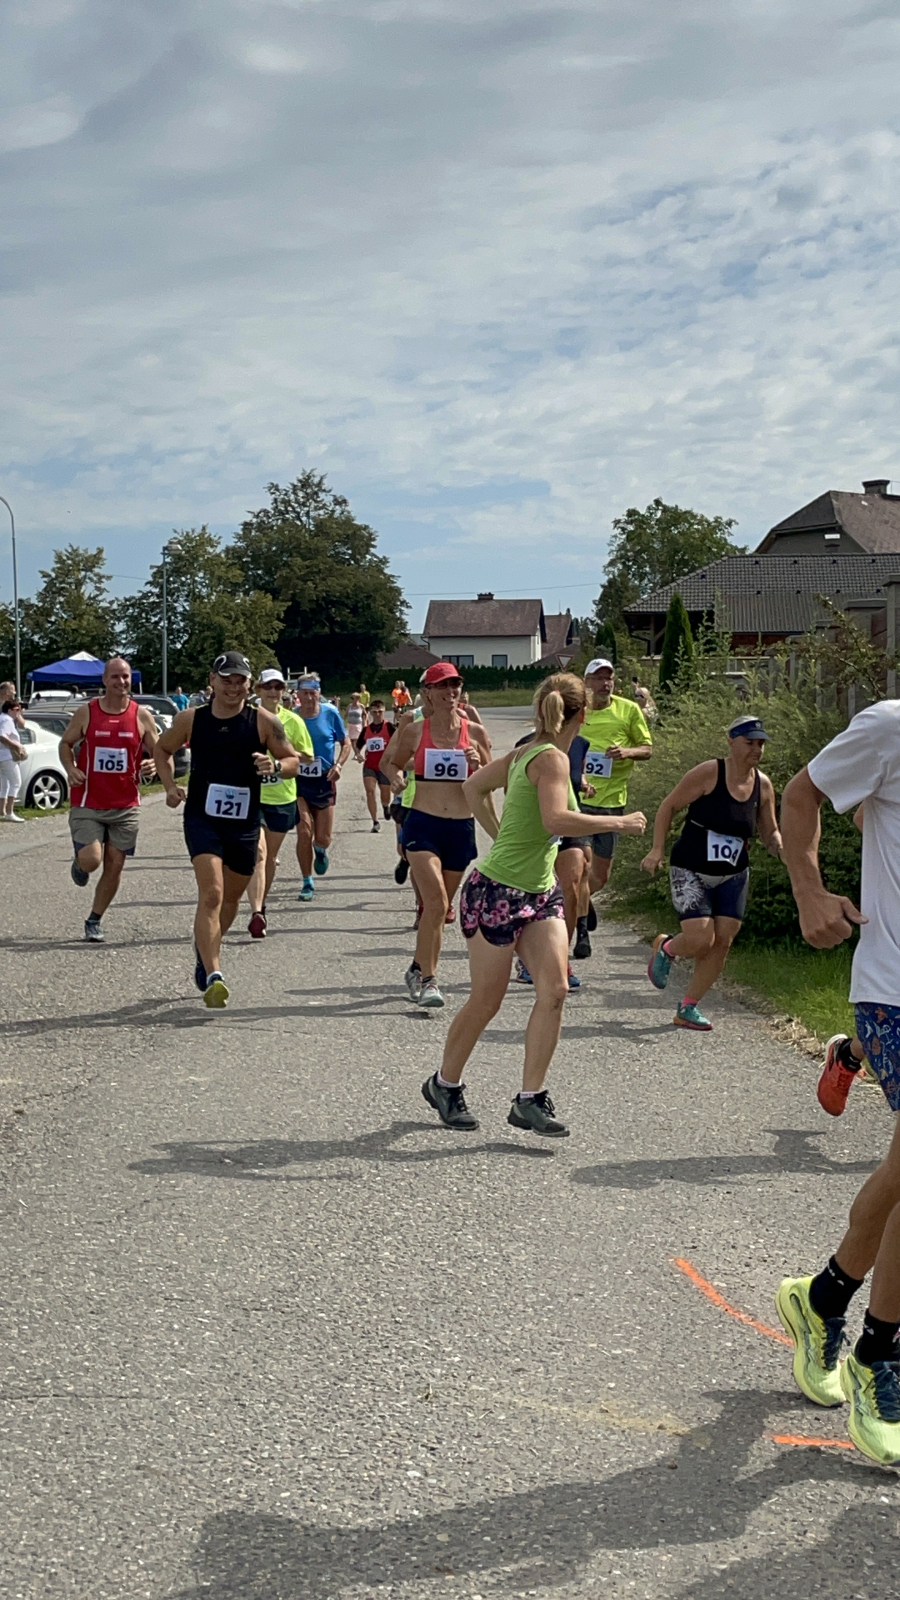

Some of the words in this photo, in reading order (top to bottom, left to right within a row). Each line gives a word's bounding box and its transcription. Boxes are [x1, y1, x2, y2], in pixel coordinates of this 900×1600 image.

[98, 759, 124, 771] 105
[299, 765, 318, 775] 144
[434, 763, 458, 777] 96
[586, 763, 604, 775] 92
[215, 800, 242, 816] 121
